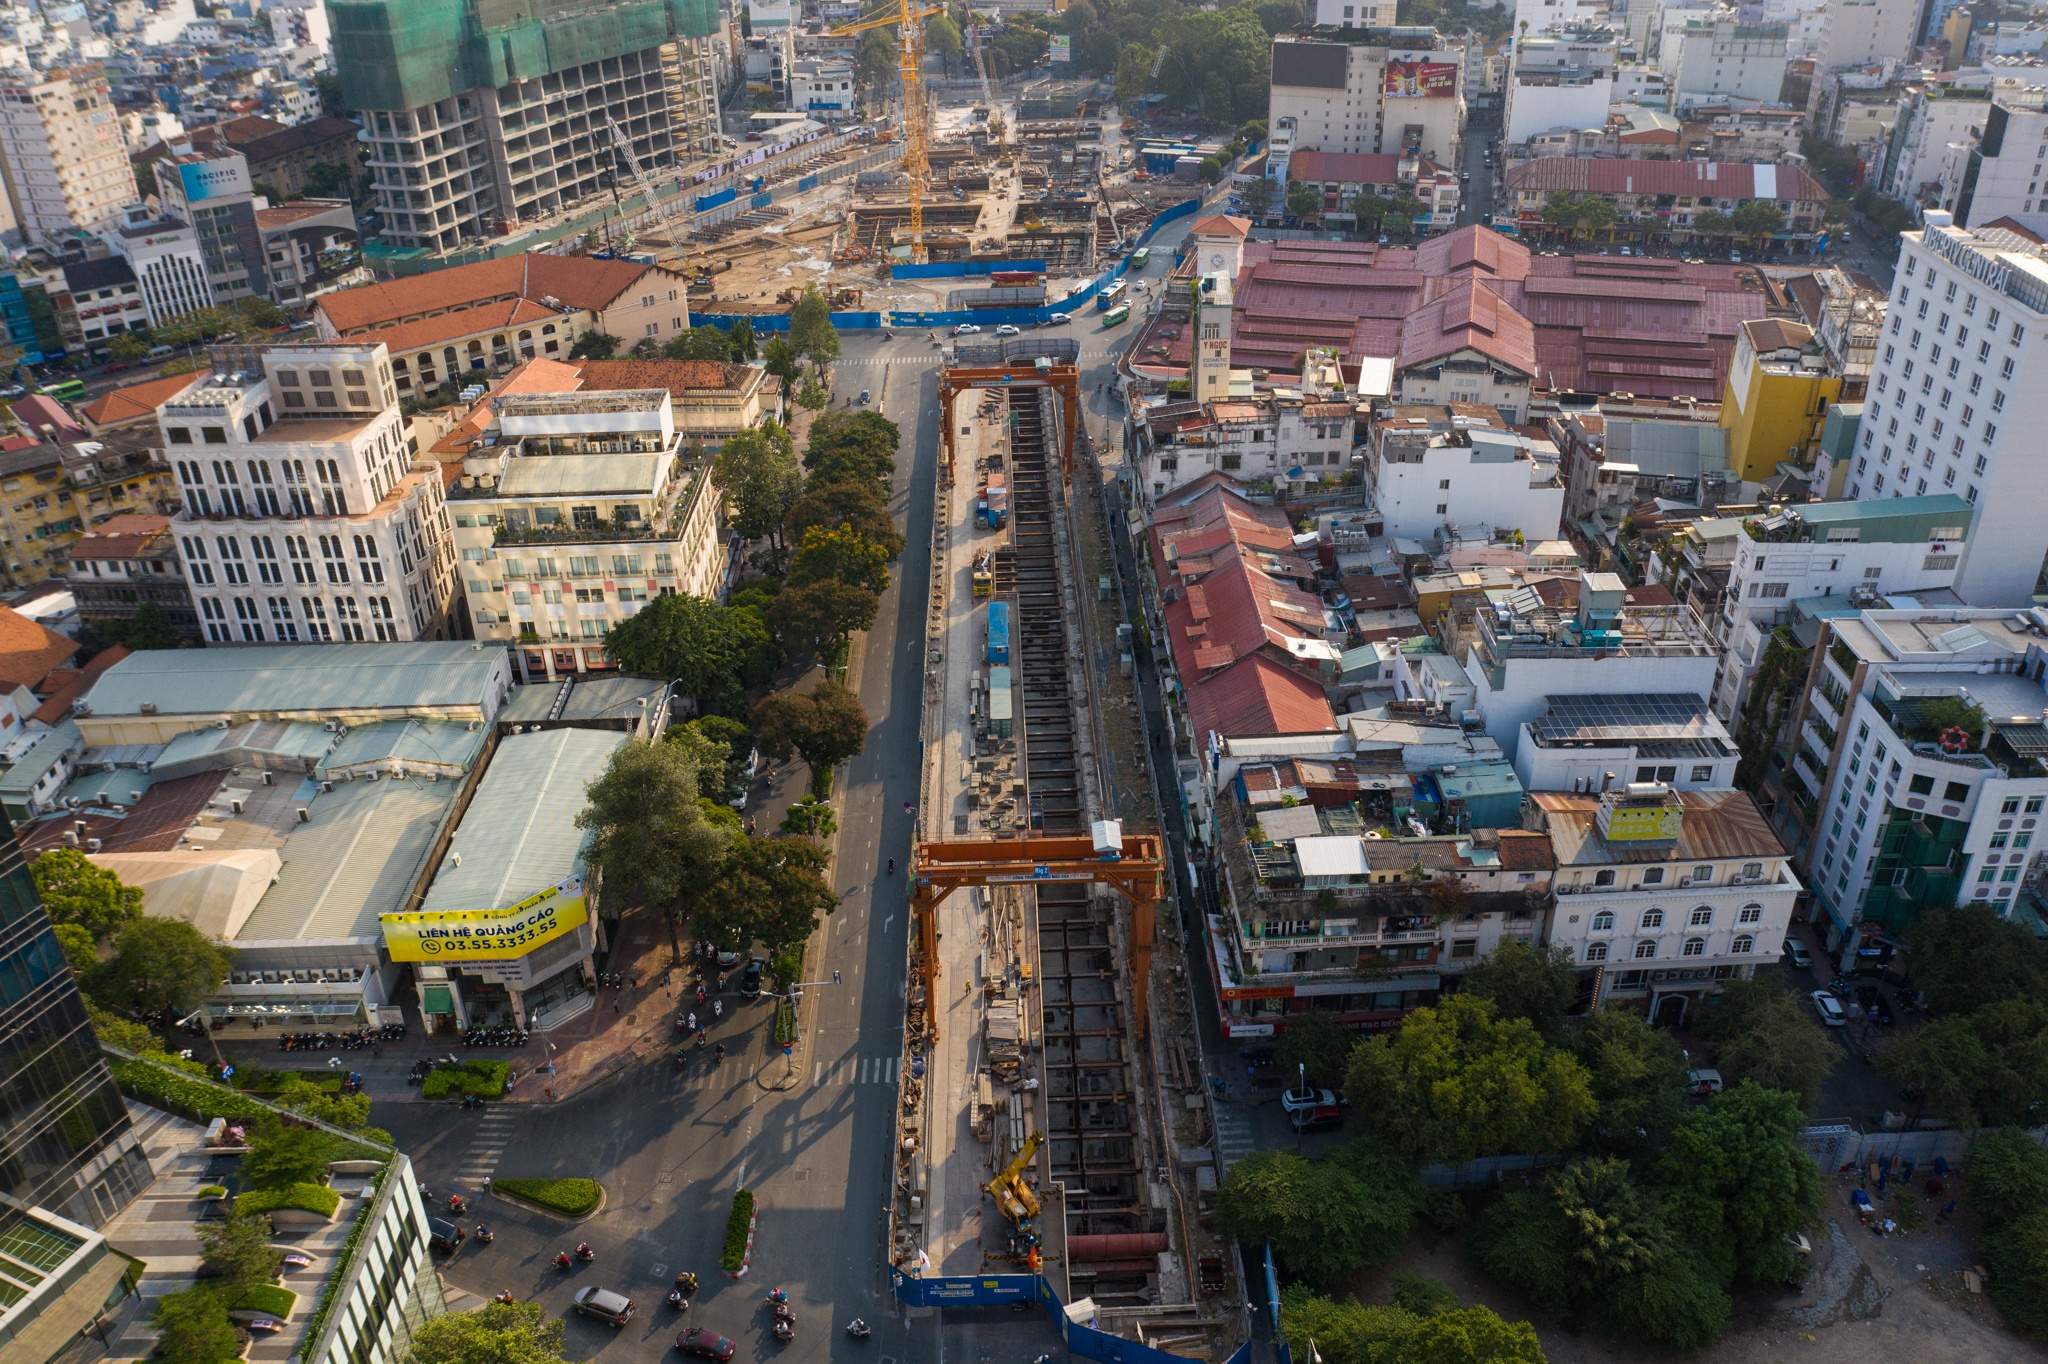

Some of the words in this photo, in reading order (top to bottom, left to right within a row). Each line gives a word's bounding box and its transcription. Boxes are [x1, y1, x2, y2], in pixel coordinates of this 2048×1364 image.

[196, 169, 237, 180] PACIFIC
[1922, 221, 1963, 267] LIBERTY
[1959, 246, 2012, 297] CENTRAL
[1613, 813, 1655, 822] BUZZA
[1611, 825, 1653, 833] PIZZA
[1035, 867, 1043, 875] Rig
[546, 892, 557, 900] ADS
[418, 927, 450, 938] LIÊN
[452, 926, 471, 939] HỆ
[475, 921, 525, 937] QUẢNG
[527, 907, 555, 926] CÁO
[445, 918, 558, 951] 03.55.3333.55
